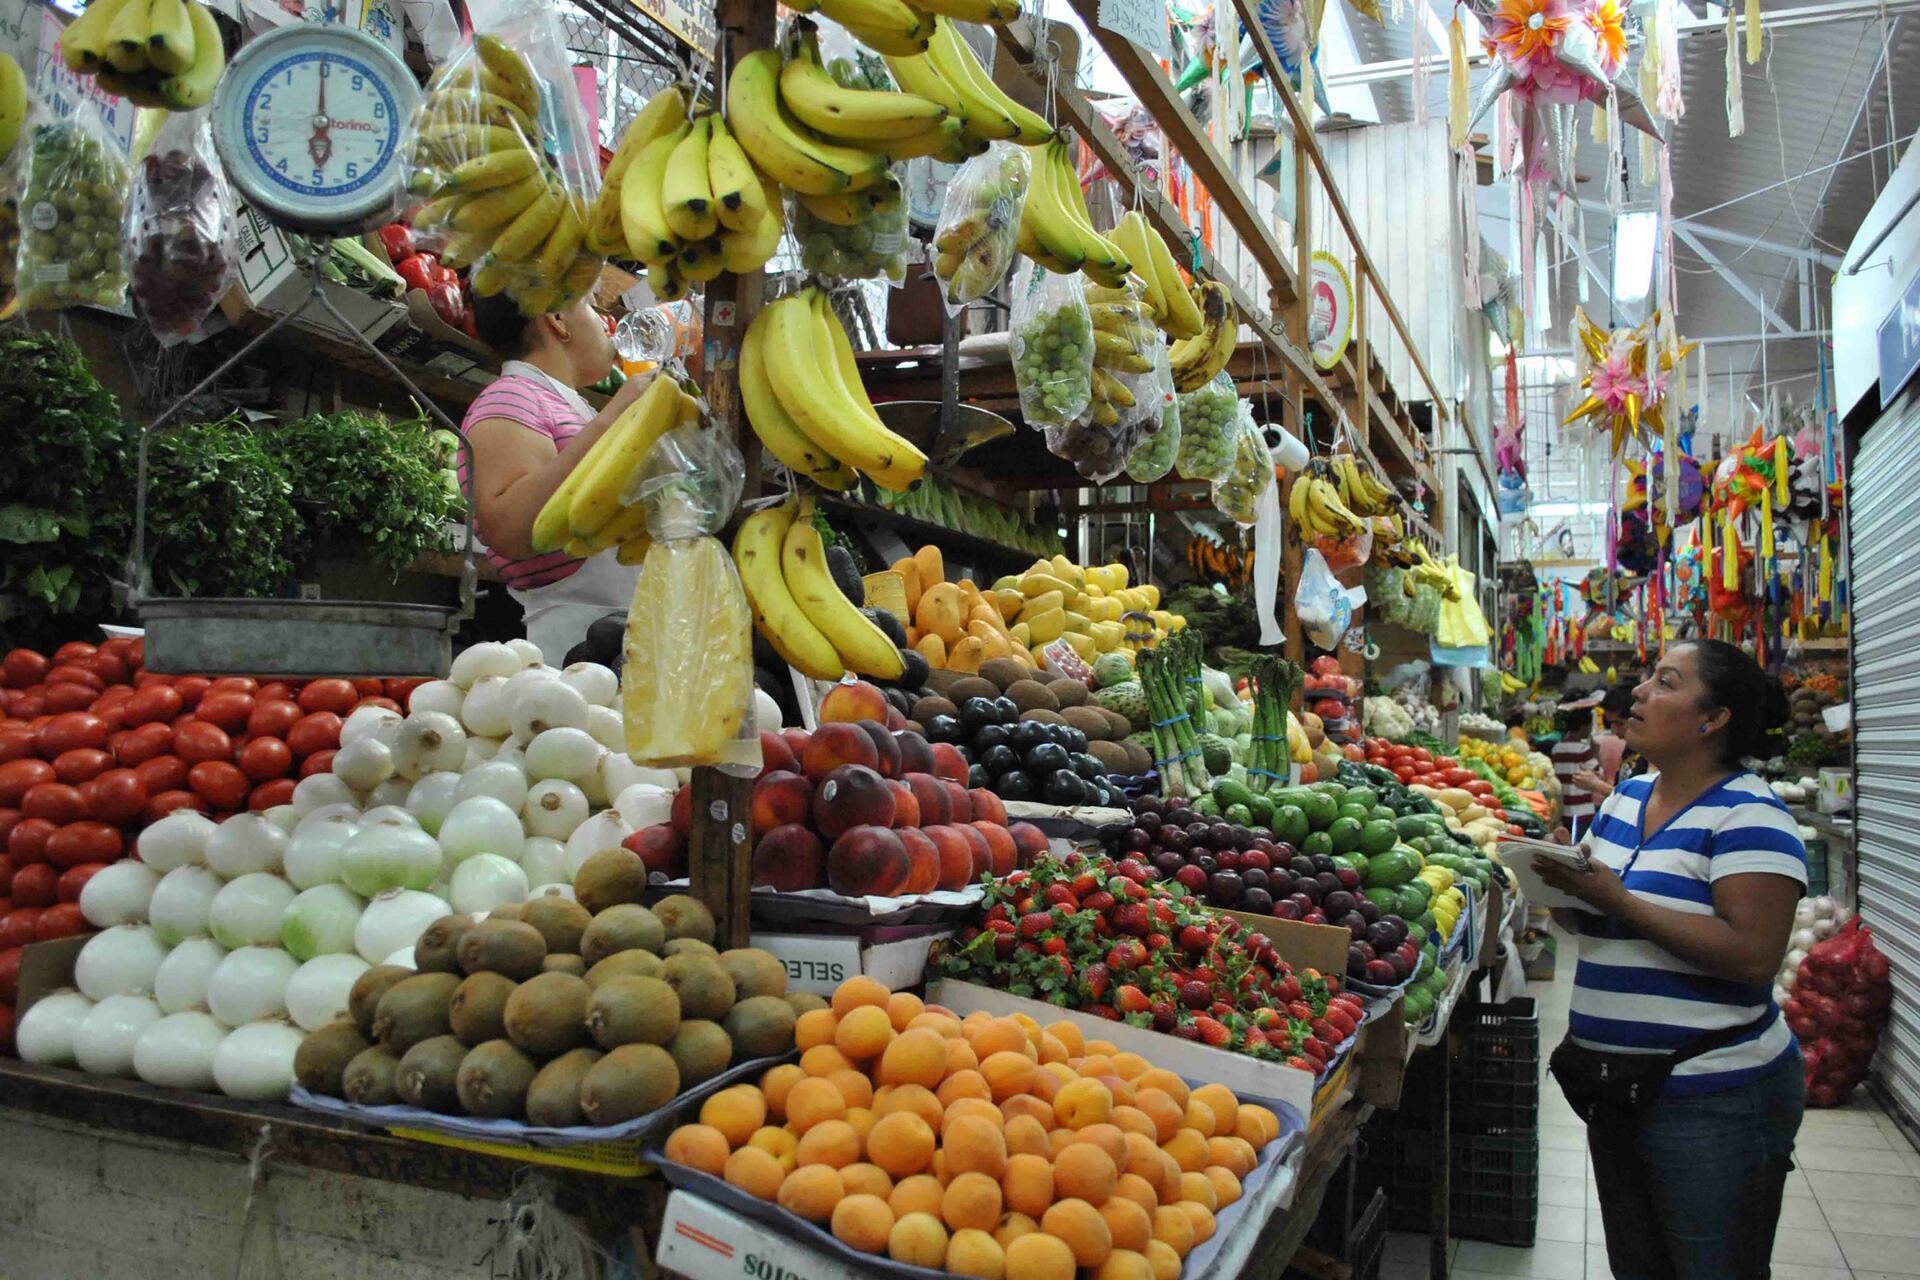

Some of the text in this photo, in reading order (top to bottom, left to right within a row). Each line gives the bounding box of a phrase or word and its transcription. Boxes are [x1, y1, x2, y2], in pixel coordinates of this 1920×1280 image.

[286, 70, 292, 85] 1
[351, 75, 363, 91] 9
[260, 94, 272, 110] 2
[374, 102, 385, 119] 8
[331, 118, 371, 132] torino
[258, 127, 269, 144] 3
[375, 139, 385, 155] 7
[275, 157, 288, 173] 4
[346, 162, 358, 178] 6
[312, 169, 324, 186] 5
